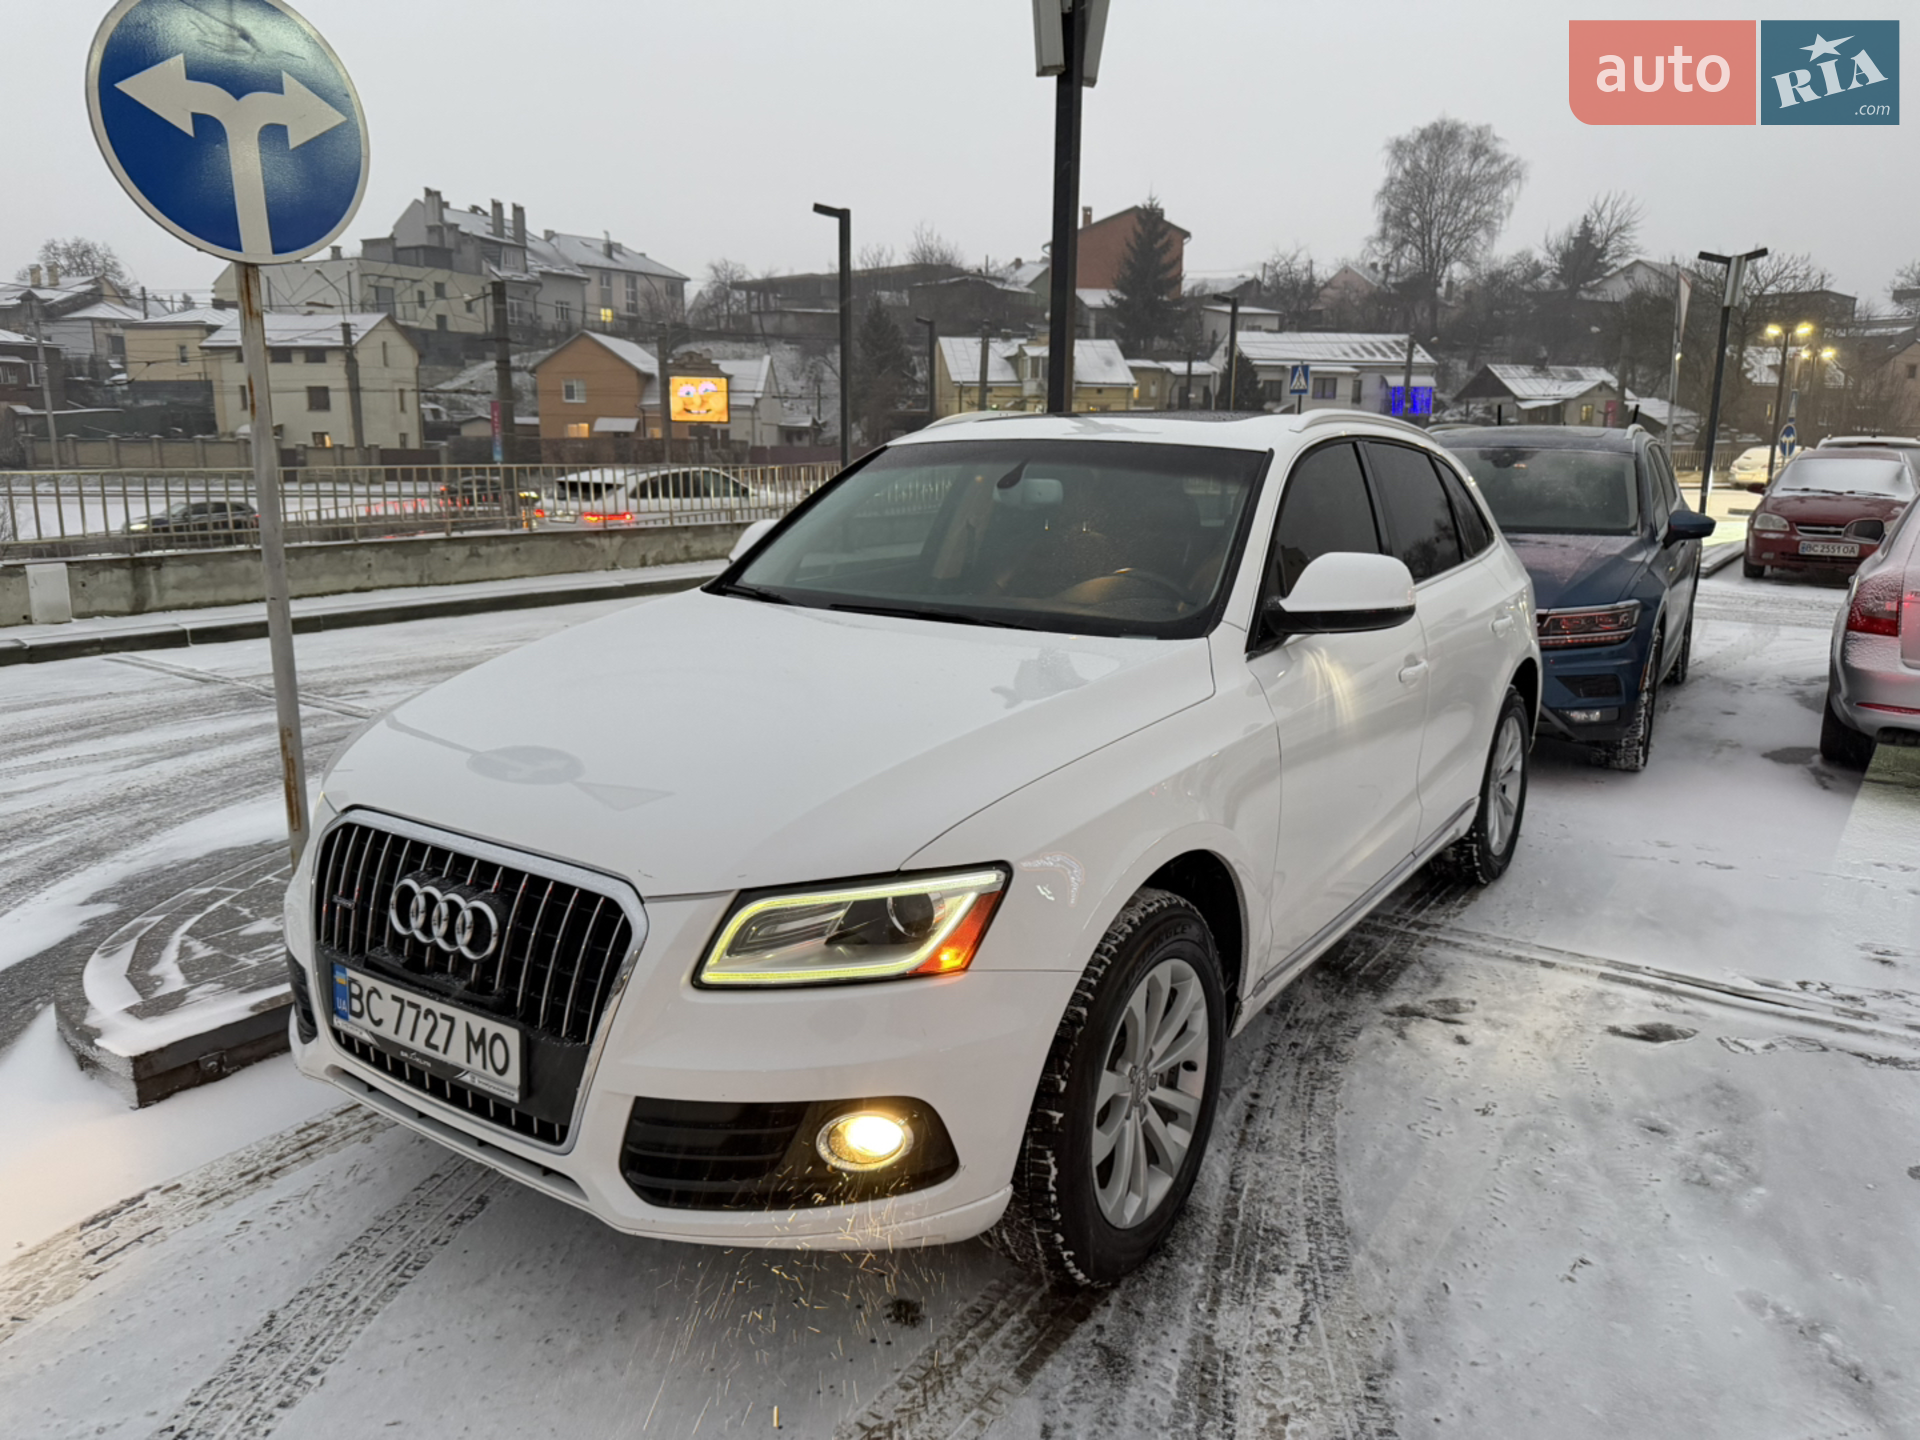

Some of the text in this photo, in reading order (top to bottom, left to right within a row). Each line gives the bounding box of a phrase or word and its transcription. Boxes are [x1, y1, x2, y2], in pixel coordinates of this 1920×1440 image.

[1806, 543, 1819, 553] BC
[1820, 545, 1841, 554] 2551
[336, 997, 348, 1013] UA
[349, 976, 510, 1077] BC 7727 MO
